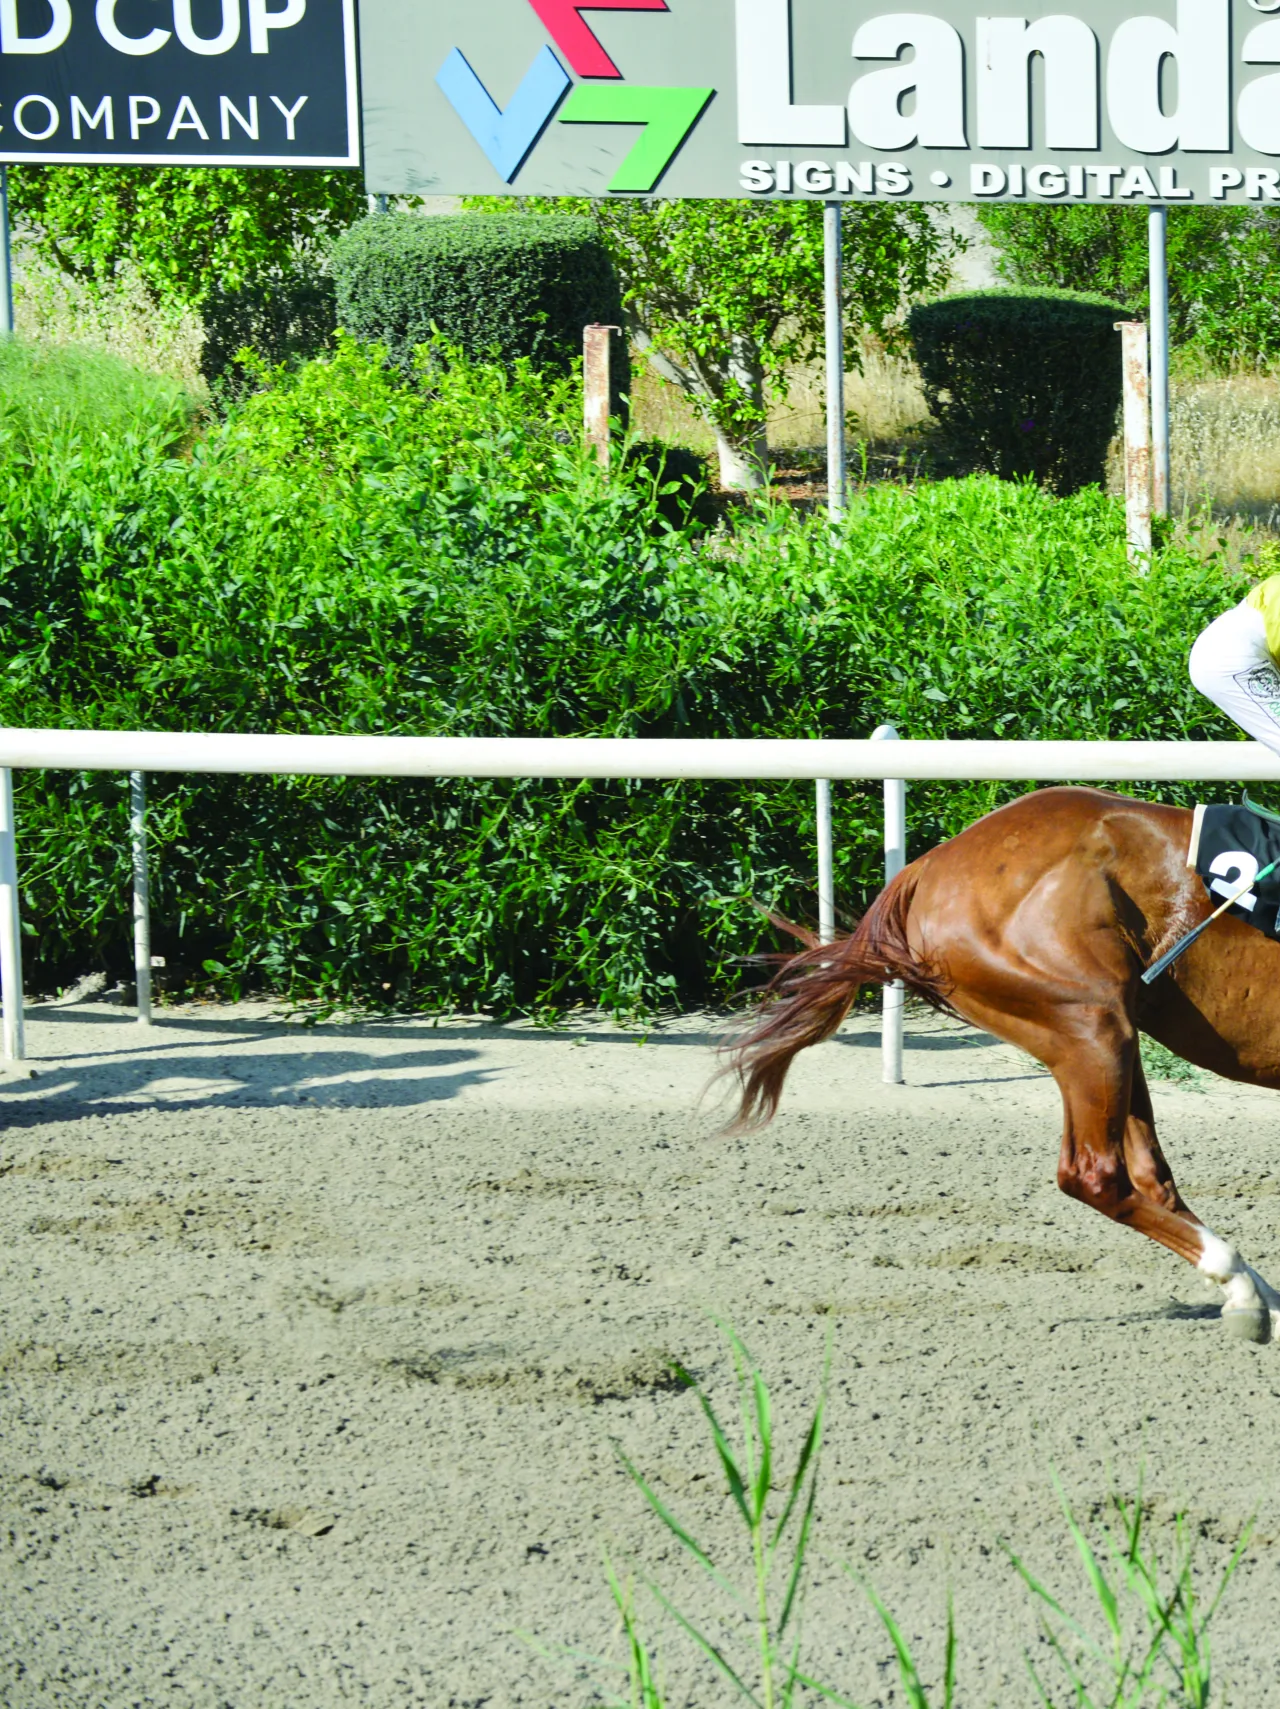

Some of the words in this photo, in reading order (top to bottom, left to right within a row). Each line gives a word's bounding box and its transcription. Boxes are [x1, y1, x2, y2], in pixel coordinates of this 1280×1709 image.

[95, 0, 307, 56] CUP
[0, 94, 309, 141] OMPANY
[739, 160, 912, 194] SIGNS
[972, 163, 1191, 199] DIGITAL
[1208, 851, 1260, 912] 2
